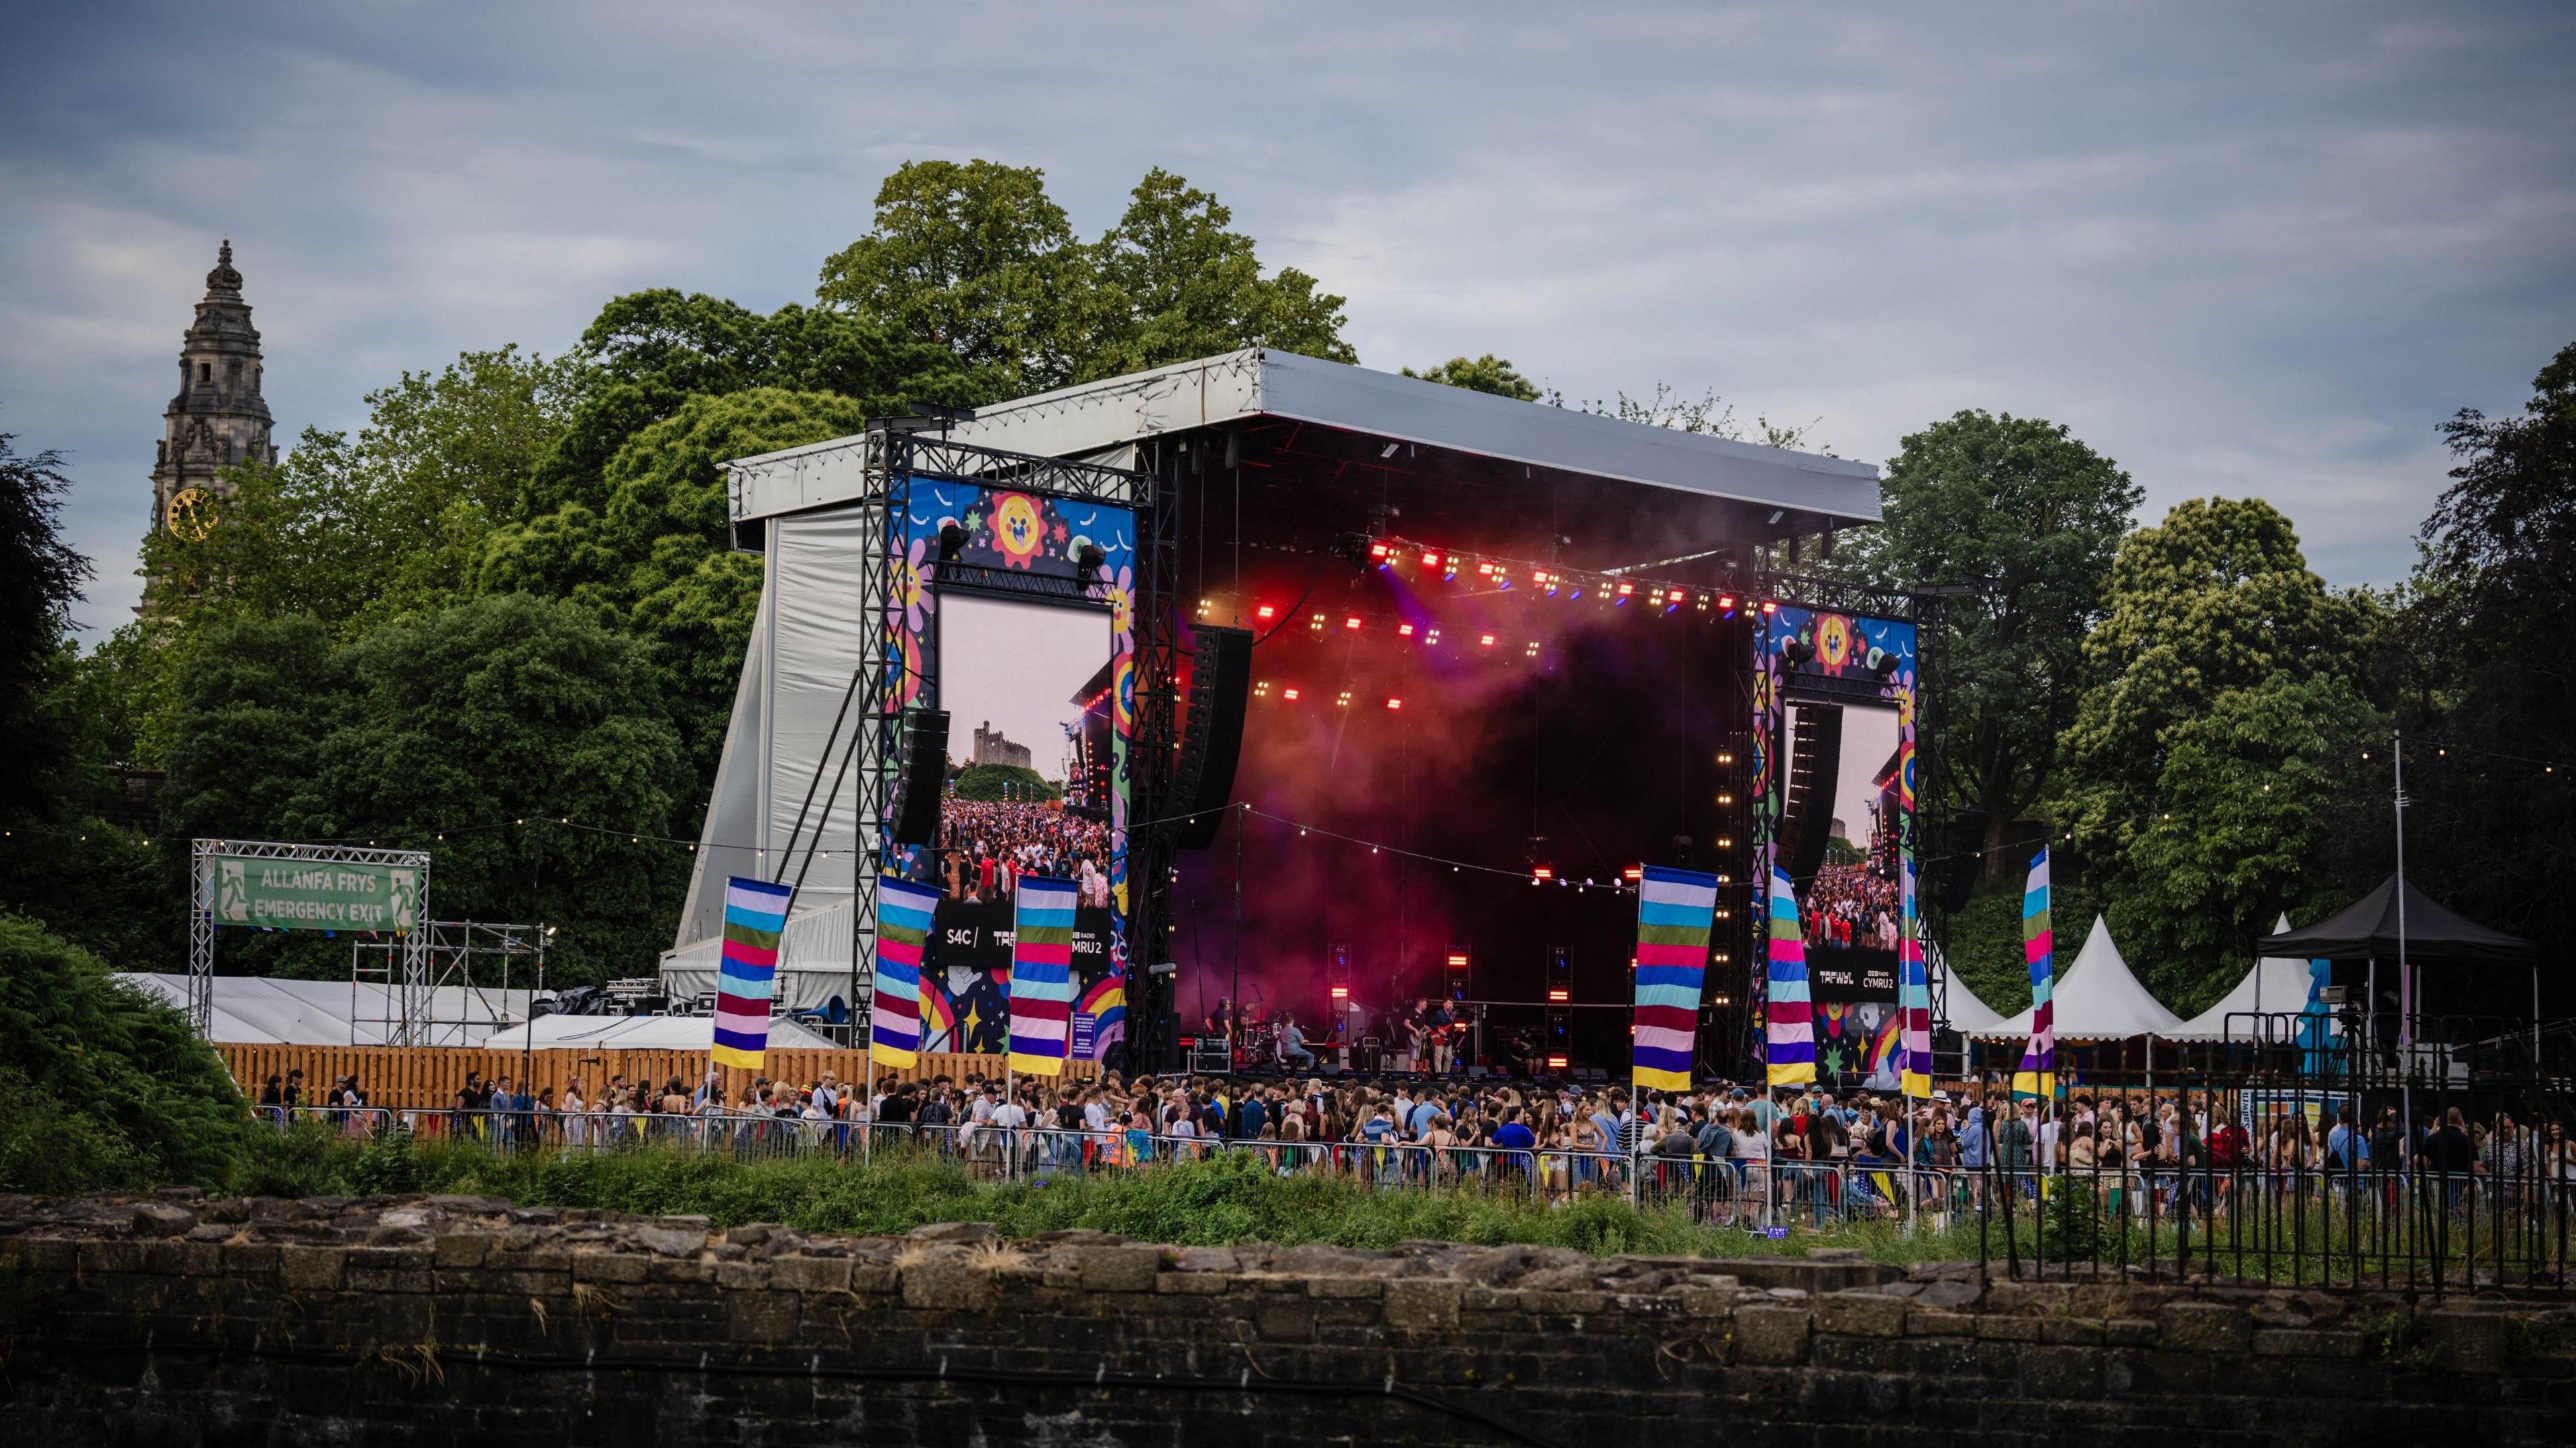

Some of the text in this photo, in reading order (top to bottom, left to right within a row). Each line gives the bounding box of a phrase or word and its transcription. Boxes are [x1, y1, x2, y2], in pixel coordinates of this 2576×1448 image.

[261, 869, 376, 892] ALLANFA FRYS
[254, 899, 382, 922] EMERGENCY EXIT
[1072, 941, 1102, 954] MRU 2
[1863, 977, 1893, 989] CYMRU 2
[2242, 1092, 2250, 1129] Sadwrn
